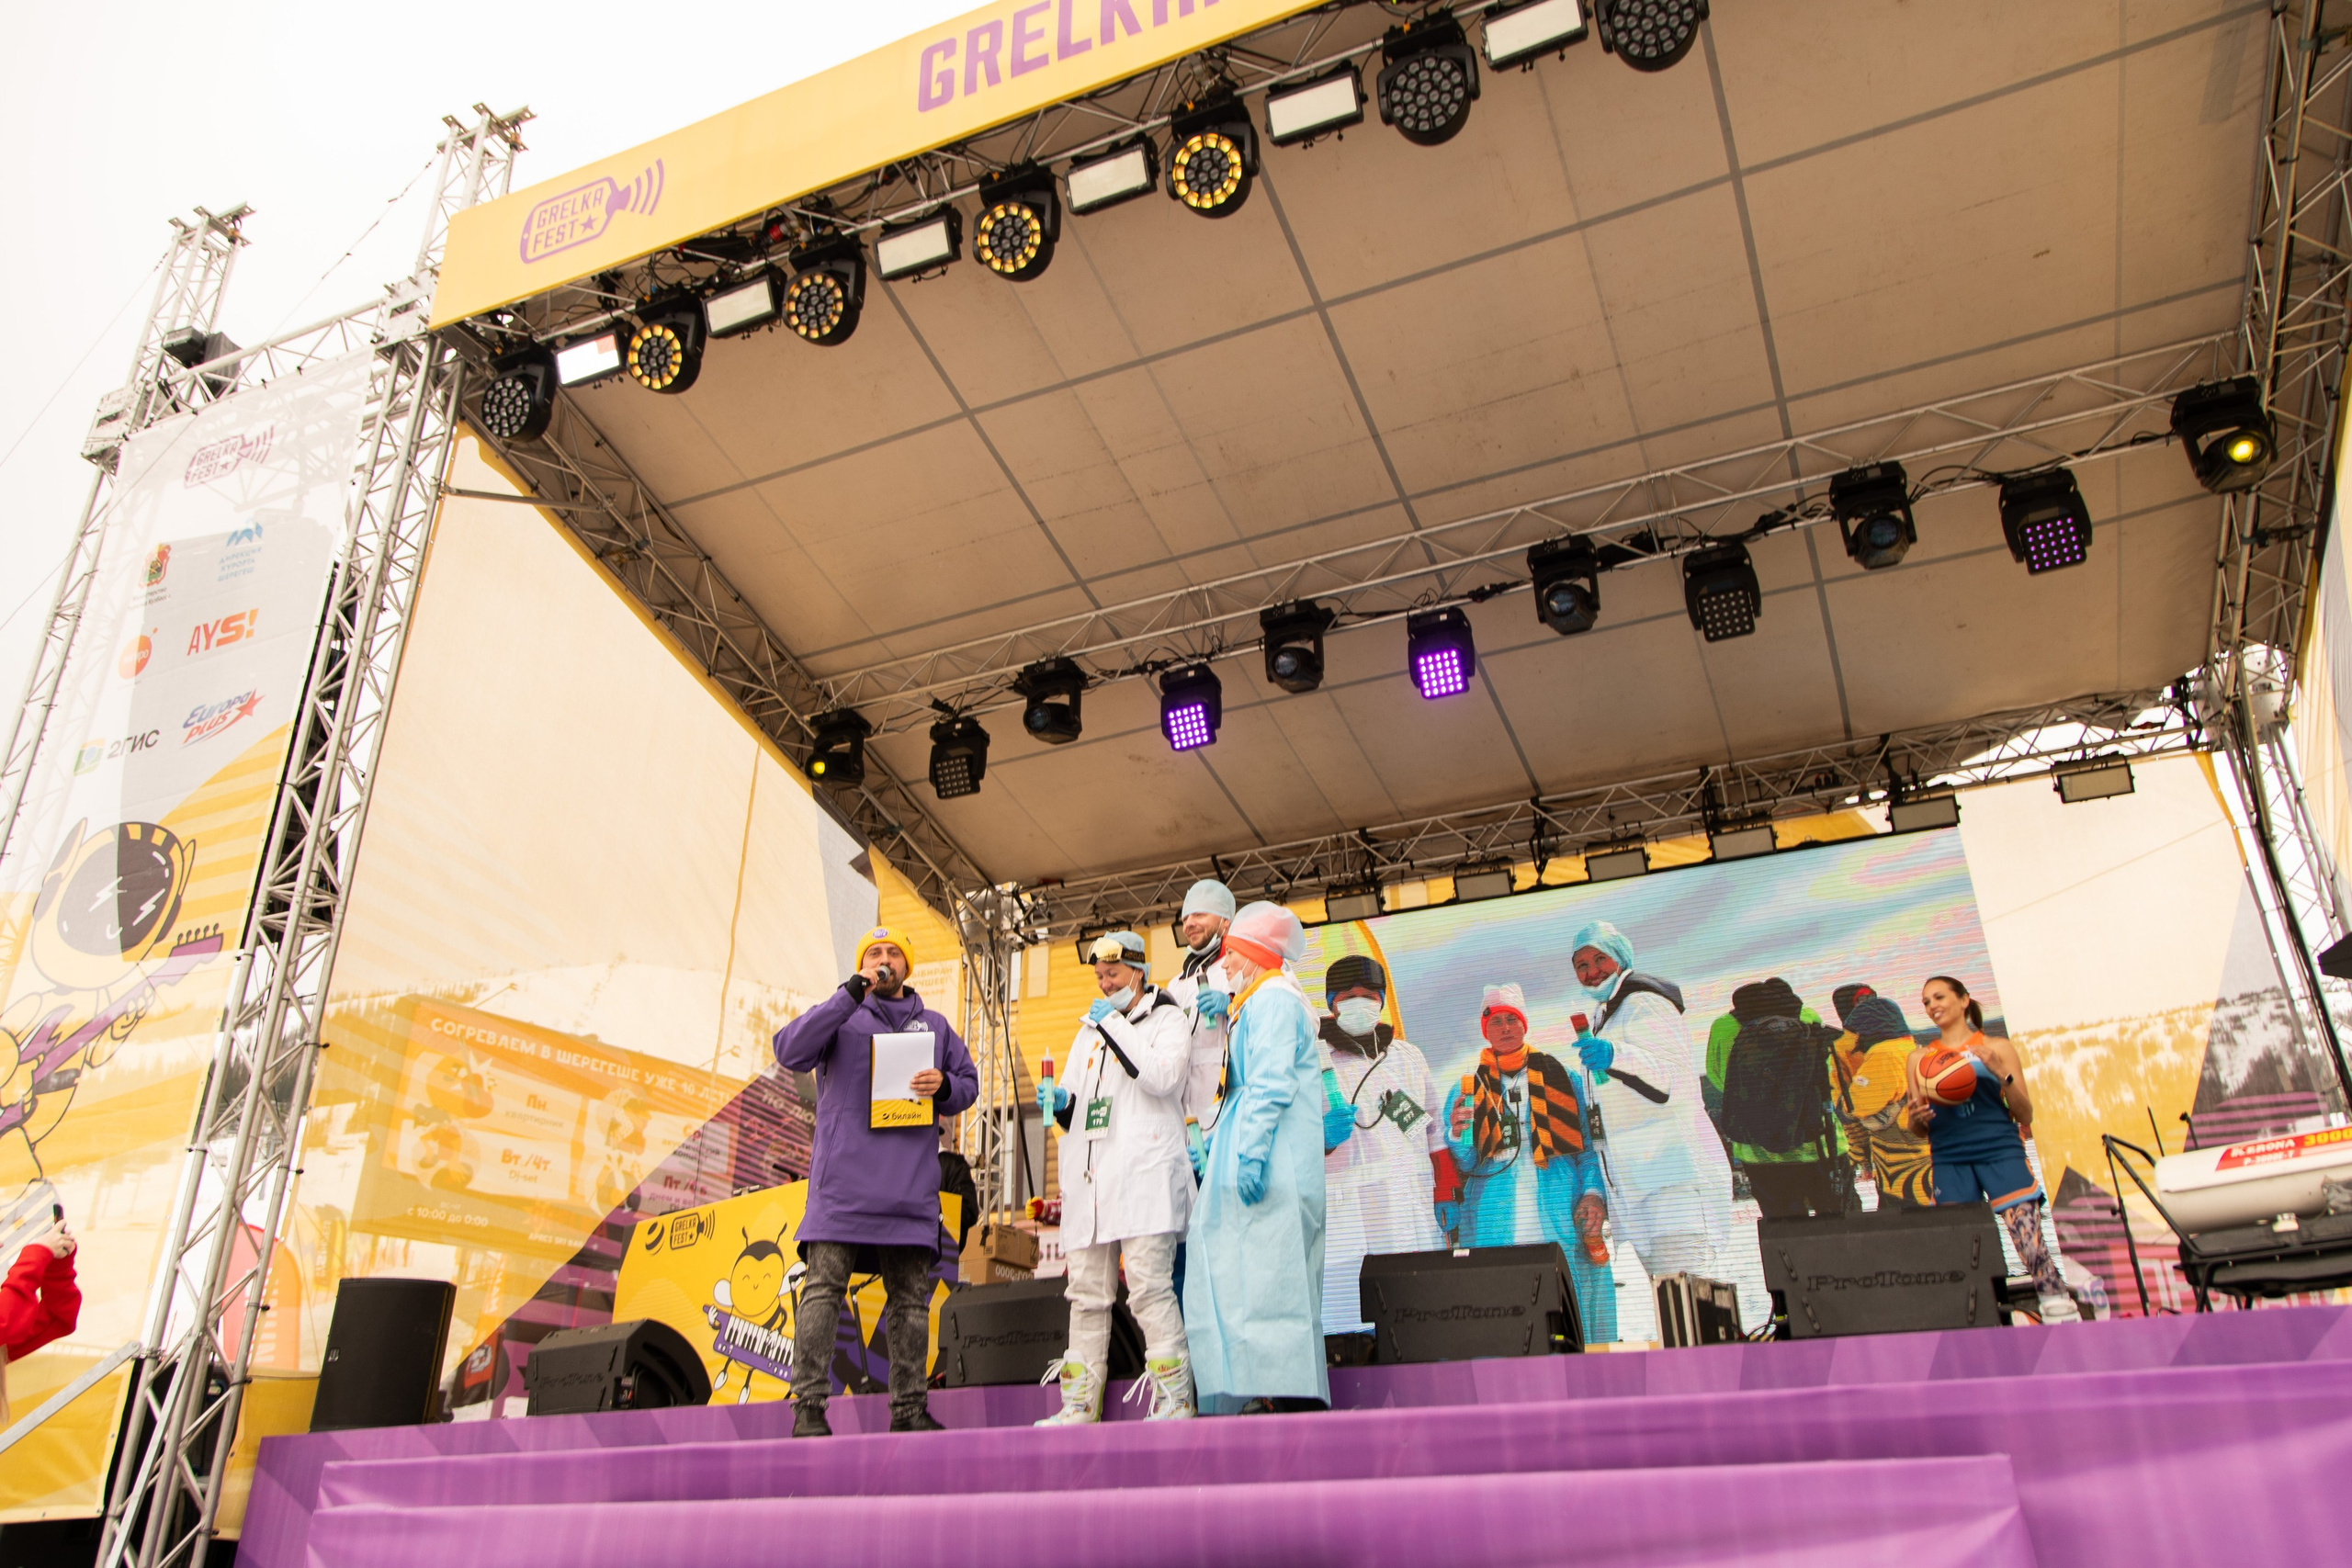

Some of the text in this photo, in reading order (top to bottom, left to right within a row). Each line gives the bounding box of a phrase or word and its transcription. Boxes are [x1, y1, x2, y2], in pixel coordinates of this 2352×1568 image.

[537, 186, 605, 230] GRELKA
[533, 219, 578, 254] FEST
[196, 440, 239, 466] GRELKA
[189, 461, 220, 482] FEST
[187, 607, 259, 657] AYS!
[107, 729, 160, 761] 2ГИС
[430, 1017, 536, 1055] СОГРЕВАЕМ
[541, 1044, 551, 1059] В
[556, 1048, 640, 1082] ШЕРЕГЕШЕ
[644, 1071, 676, 1091] УЖЕ
[682, 1083, 695, 1096] 10
[891, 1111, 922, 1121] билайн
[416, 1206, 447, 1221] 10:00
[447, 1213, 462, 1224] до
[464, 1213, 489, 1228] 0:00
[674, 1217, 696, 1233] GRELKA
[673, 1232, 688, 1245] FEST
[1807, 1270, 1966, 1292] ProTone
[1395, 1304, 1526, 1324] ProTone
[962, 1329, 1064, 1349] ProTone
